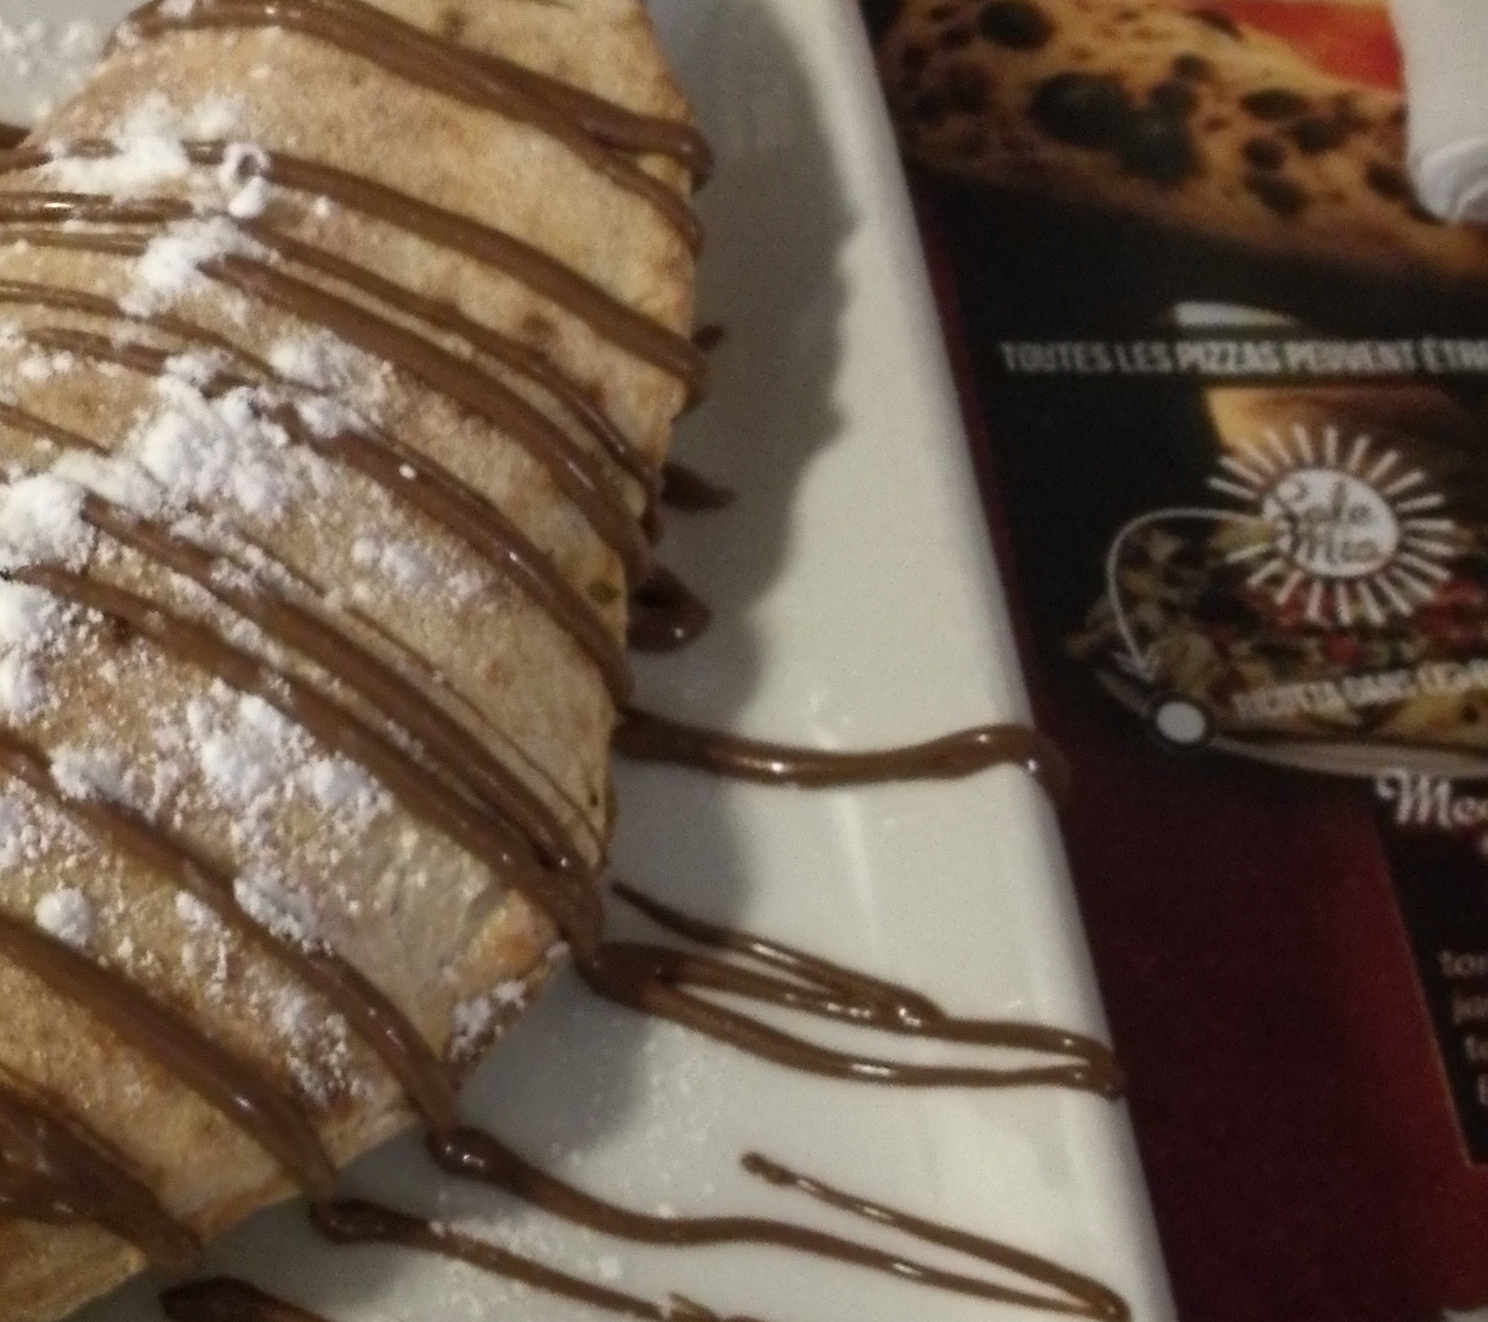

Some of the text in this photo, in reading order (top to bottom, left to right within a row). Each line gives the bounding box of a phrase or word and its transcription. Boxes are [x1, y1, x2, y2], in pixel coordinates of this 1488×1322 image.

[999, 340, 1112, 373] TOUTES
[1114, 340, 1173, 372] LES
[1174, 339, 1282, 374] PIZZAS
